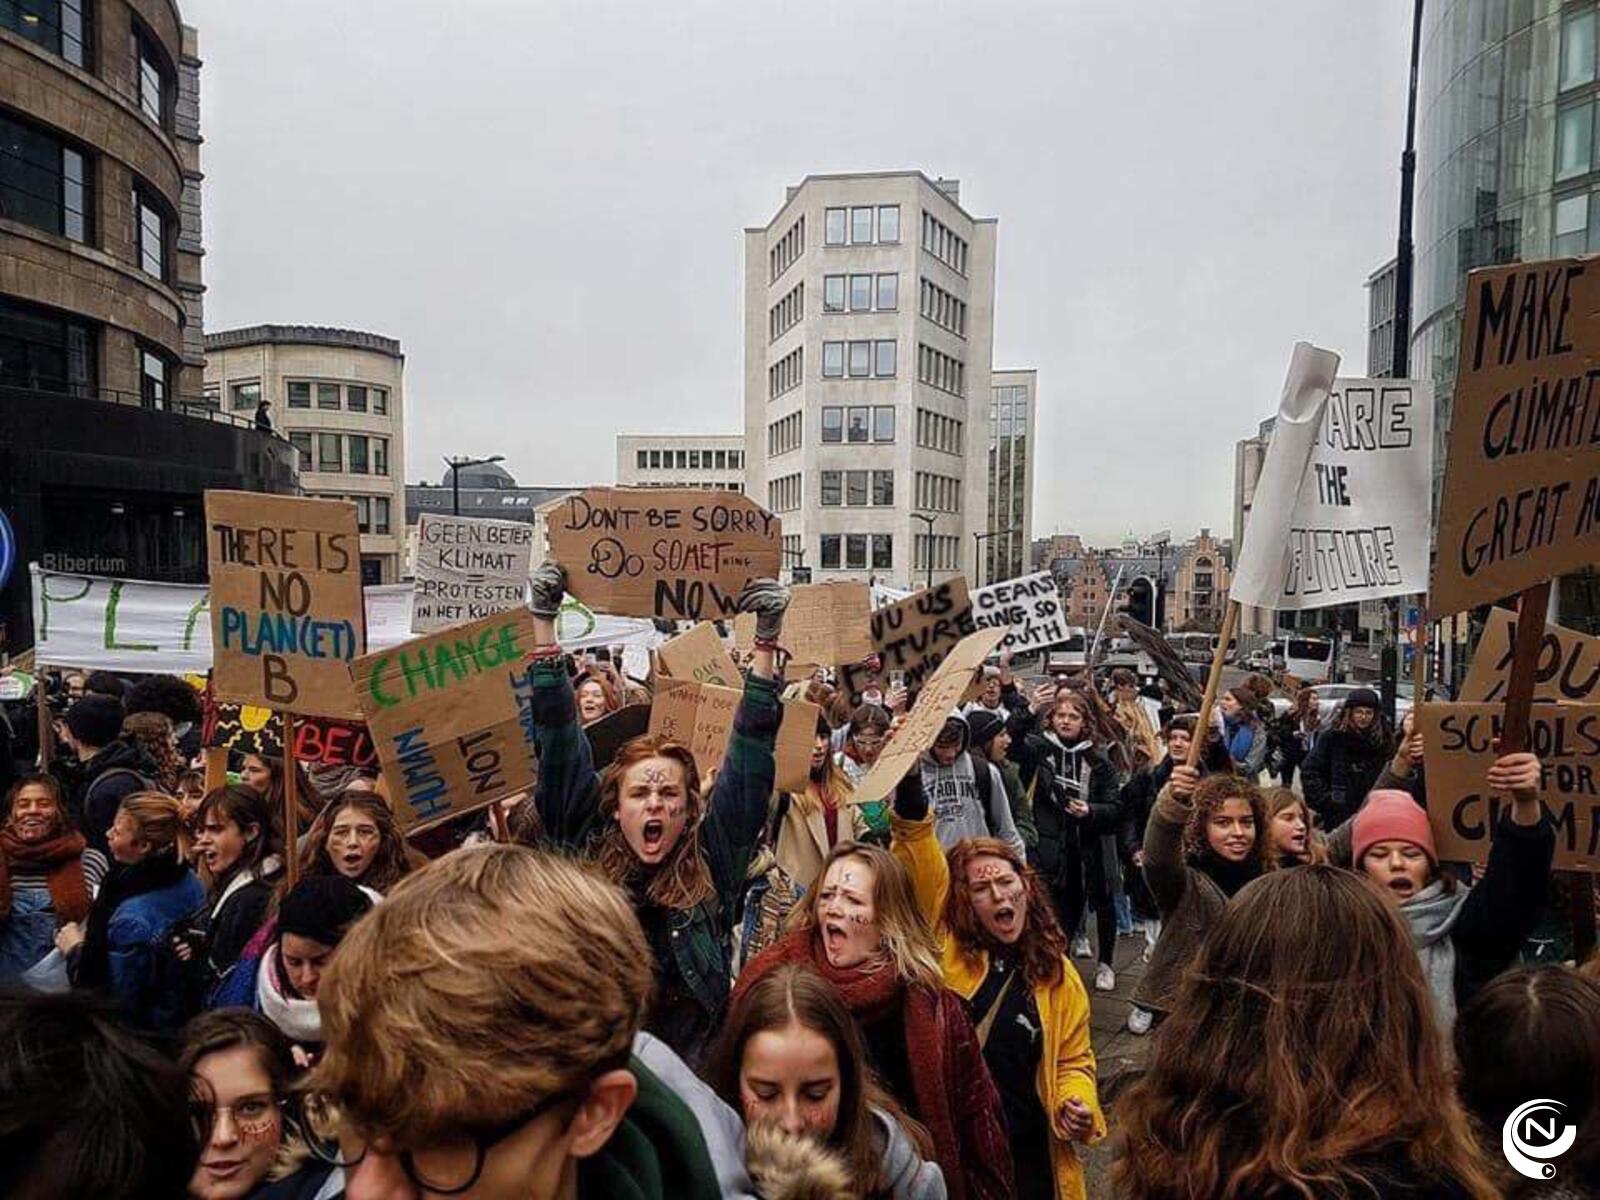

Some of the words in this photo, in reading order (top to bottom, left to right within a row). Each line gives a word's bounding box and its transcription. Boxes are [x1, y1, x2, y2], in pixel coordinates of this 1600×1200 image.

[1473, 267, 1585, 371] MAKE
[1326, 387, 1413, 451] ARE
[1314, 463, 1351, 506] THE
[487, 526, 532, 547] BETER
[645, 508, 681, 529] BE
[692, 506, 775, 539] SORRY,
[1461, 482, 1571, 577] GREAT
[1575, 477, 1600, 536] A
[43, 552, 126, 572] Biberium
[213, 525, 297, 568] THERE
[316, 534, 349, 574] IS
[439, 547, 517, 570] KLIMAAT
[1284, 526, 1402, 595] FUTURE
[260, 572, 311, 617] NO
[417, 605, 431, 618] IN
[437, 606, 463, 619] HET
[422, 580, 523, 601] PROTESTEN
[655, 579, 744, 619] NOW
[916, 583, 954, 615] US
[1034, 600, 1057, 618] SO
[222, 607, 356, 660] PLAN(ET)
[996, 620, 1062, 650] OUTH
[264, 655, 298, 703] B
[368, 621, 523, 710] CHANGE
[1439, 714, 1600, 757] SCOLS
[392, 725, 453, 819] HUMAN
[456, 730, 507, 796] NOT
[1540, 763, 1597, 796] FOR
